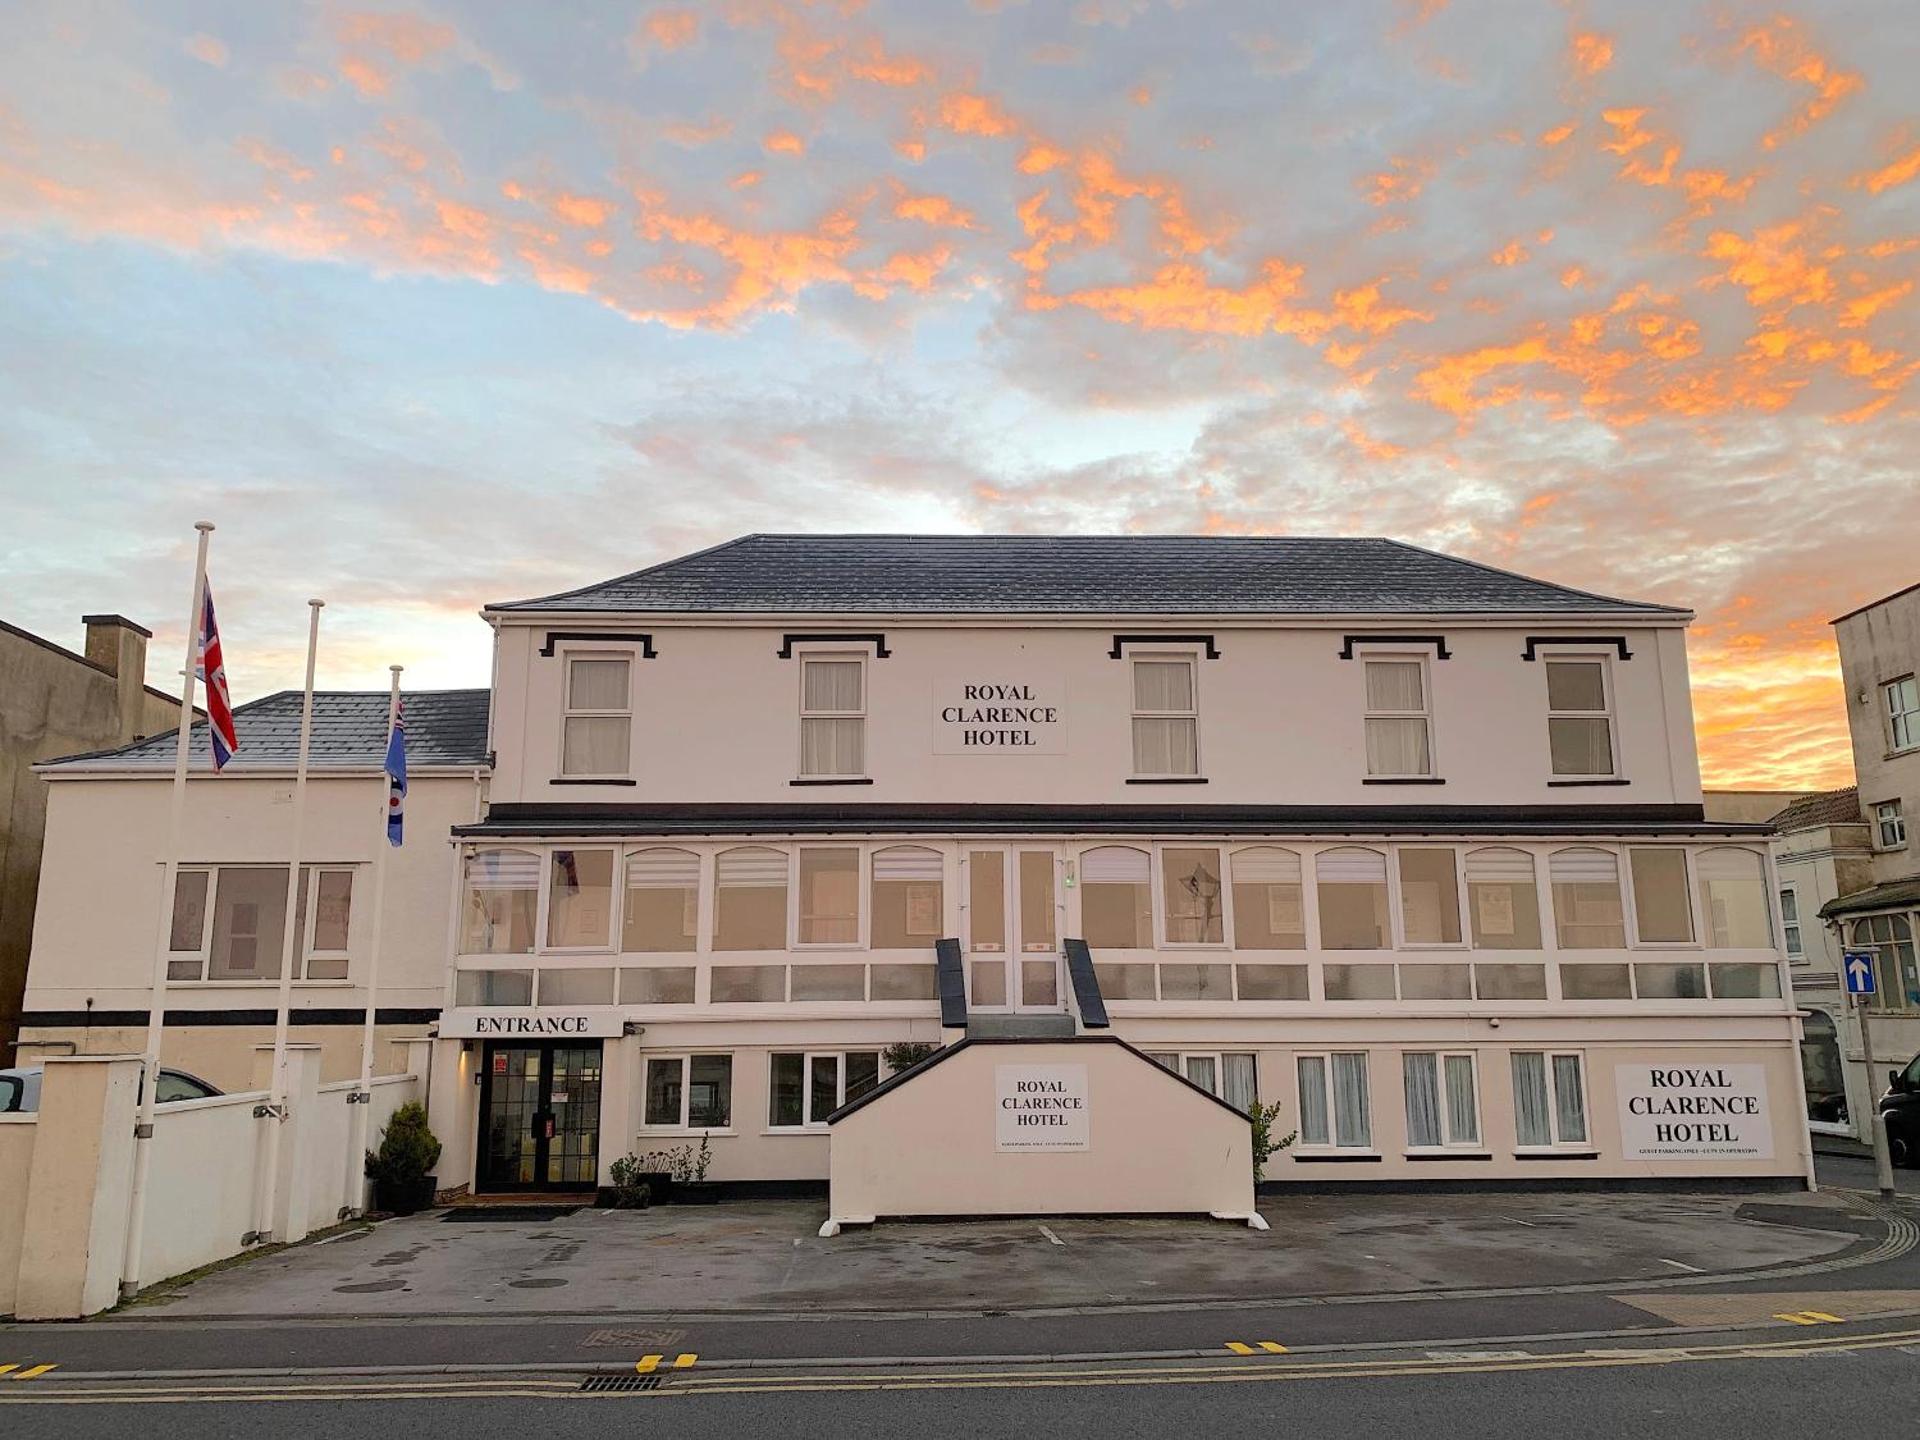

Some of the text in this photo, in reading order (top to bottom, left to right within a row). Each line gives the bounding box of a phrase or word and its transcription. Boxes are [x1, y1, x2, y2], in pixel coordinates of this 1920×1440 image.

[964, 685, 1036, 700] ROYAL
[942, 707, 1057, 723] CLARENCE
[964, 730, 1037, 746] HOTEL
[475, 1017, 588, 1033] ENTRANCE
[1017, 1080, 1067, 1093] ROYAL
[1650, 1069, 1732, 1088] ROYAL
[1002, 1097, 1083, 1110] CLARENCE
[1629, 1096, 1760, 1115] CLARENCE
[1017, 1114, 1068, 1126] HOTEL
[1656, 1123, 1739, 1142] HOTEL
